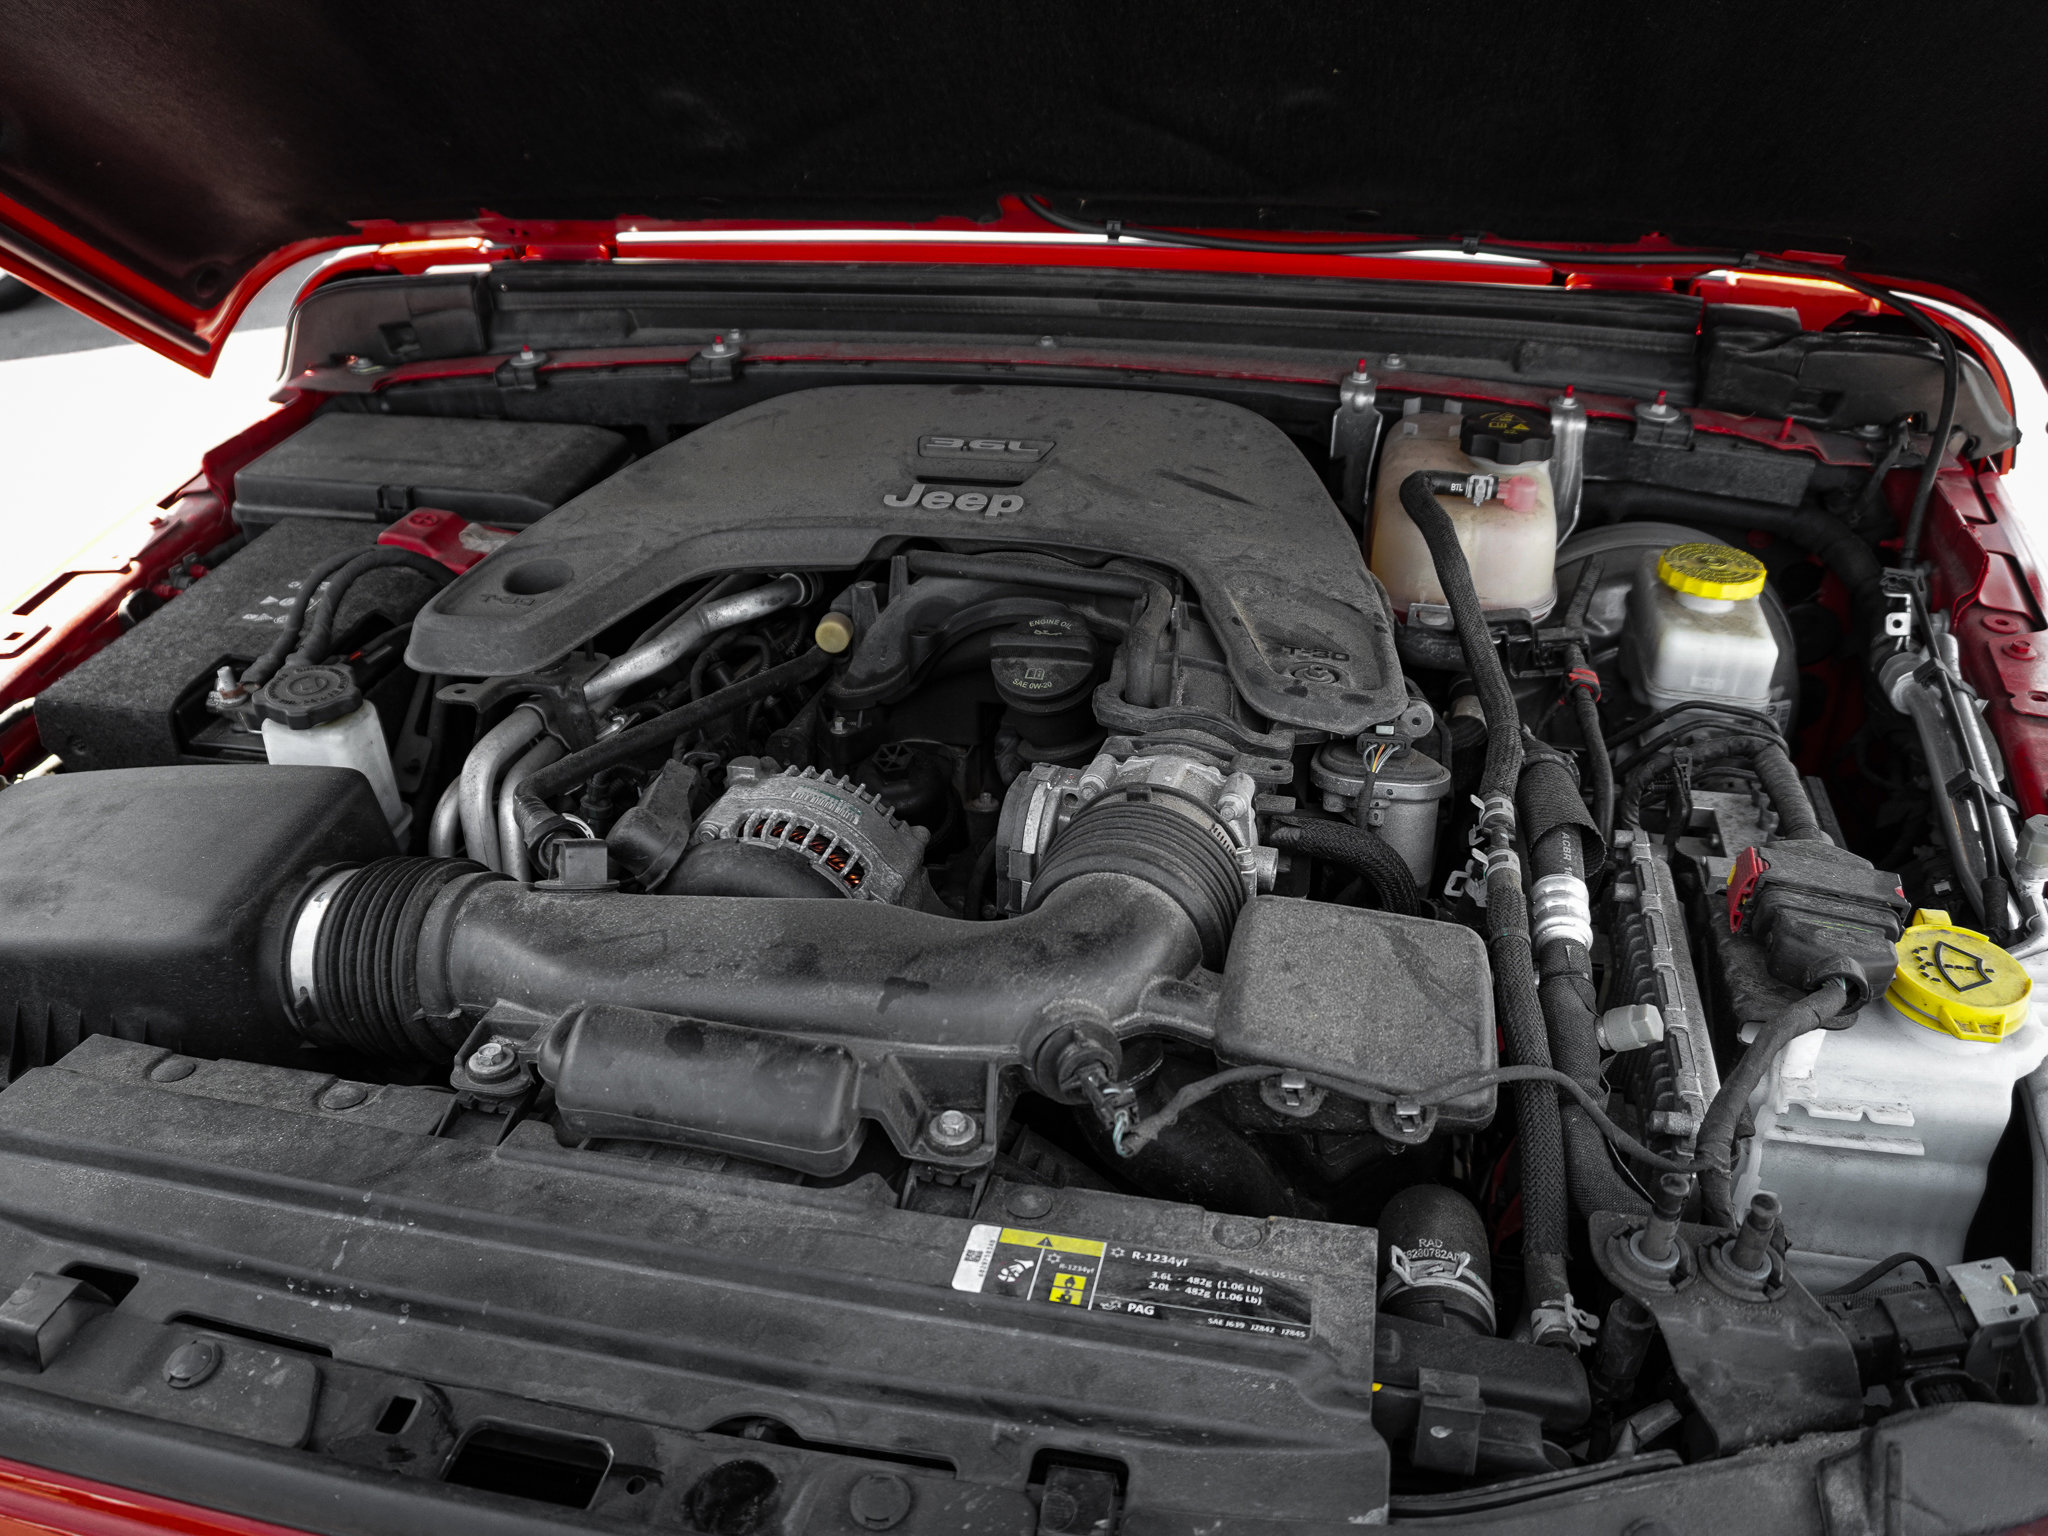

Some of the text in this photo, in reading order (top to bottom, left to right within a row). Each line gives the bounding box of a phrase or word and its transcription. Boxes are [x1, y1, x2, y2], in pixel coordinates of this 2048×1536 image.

[883, 483, 1024, 519] Jeep
[1029, 619, 1073, 630] ENGINE OIL
[1284, 645, 1350, 662] T-30
[1012, 678, 1053, 690] SAE 0W-20
[1418, 1238, 1443, 1248] RAD
[1131, 1250, 1189, 1268] R-1234yf
[1151, 1271, 1173, 1281] 3.6L
[1186, 1276, 1213, 1288] 482g
[1217, 1280, 1245, 1292] (1.06
[1246, 1284, 1264, 1295] Lb)
[1148, 1281, 1170, 1291] 2.0L
[1184, 1286, 1211, 1299] 482g
[1215, 1290, 1243, 1302] (1.06
[1245, 1295, 1262, 1306] Lb)
[1127, 1302, 1155, 1316] PAG
[1207, 1317, 1224, 1327] SAE
